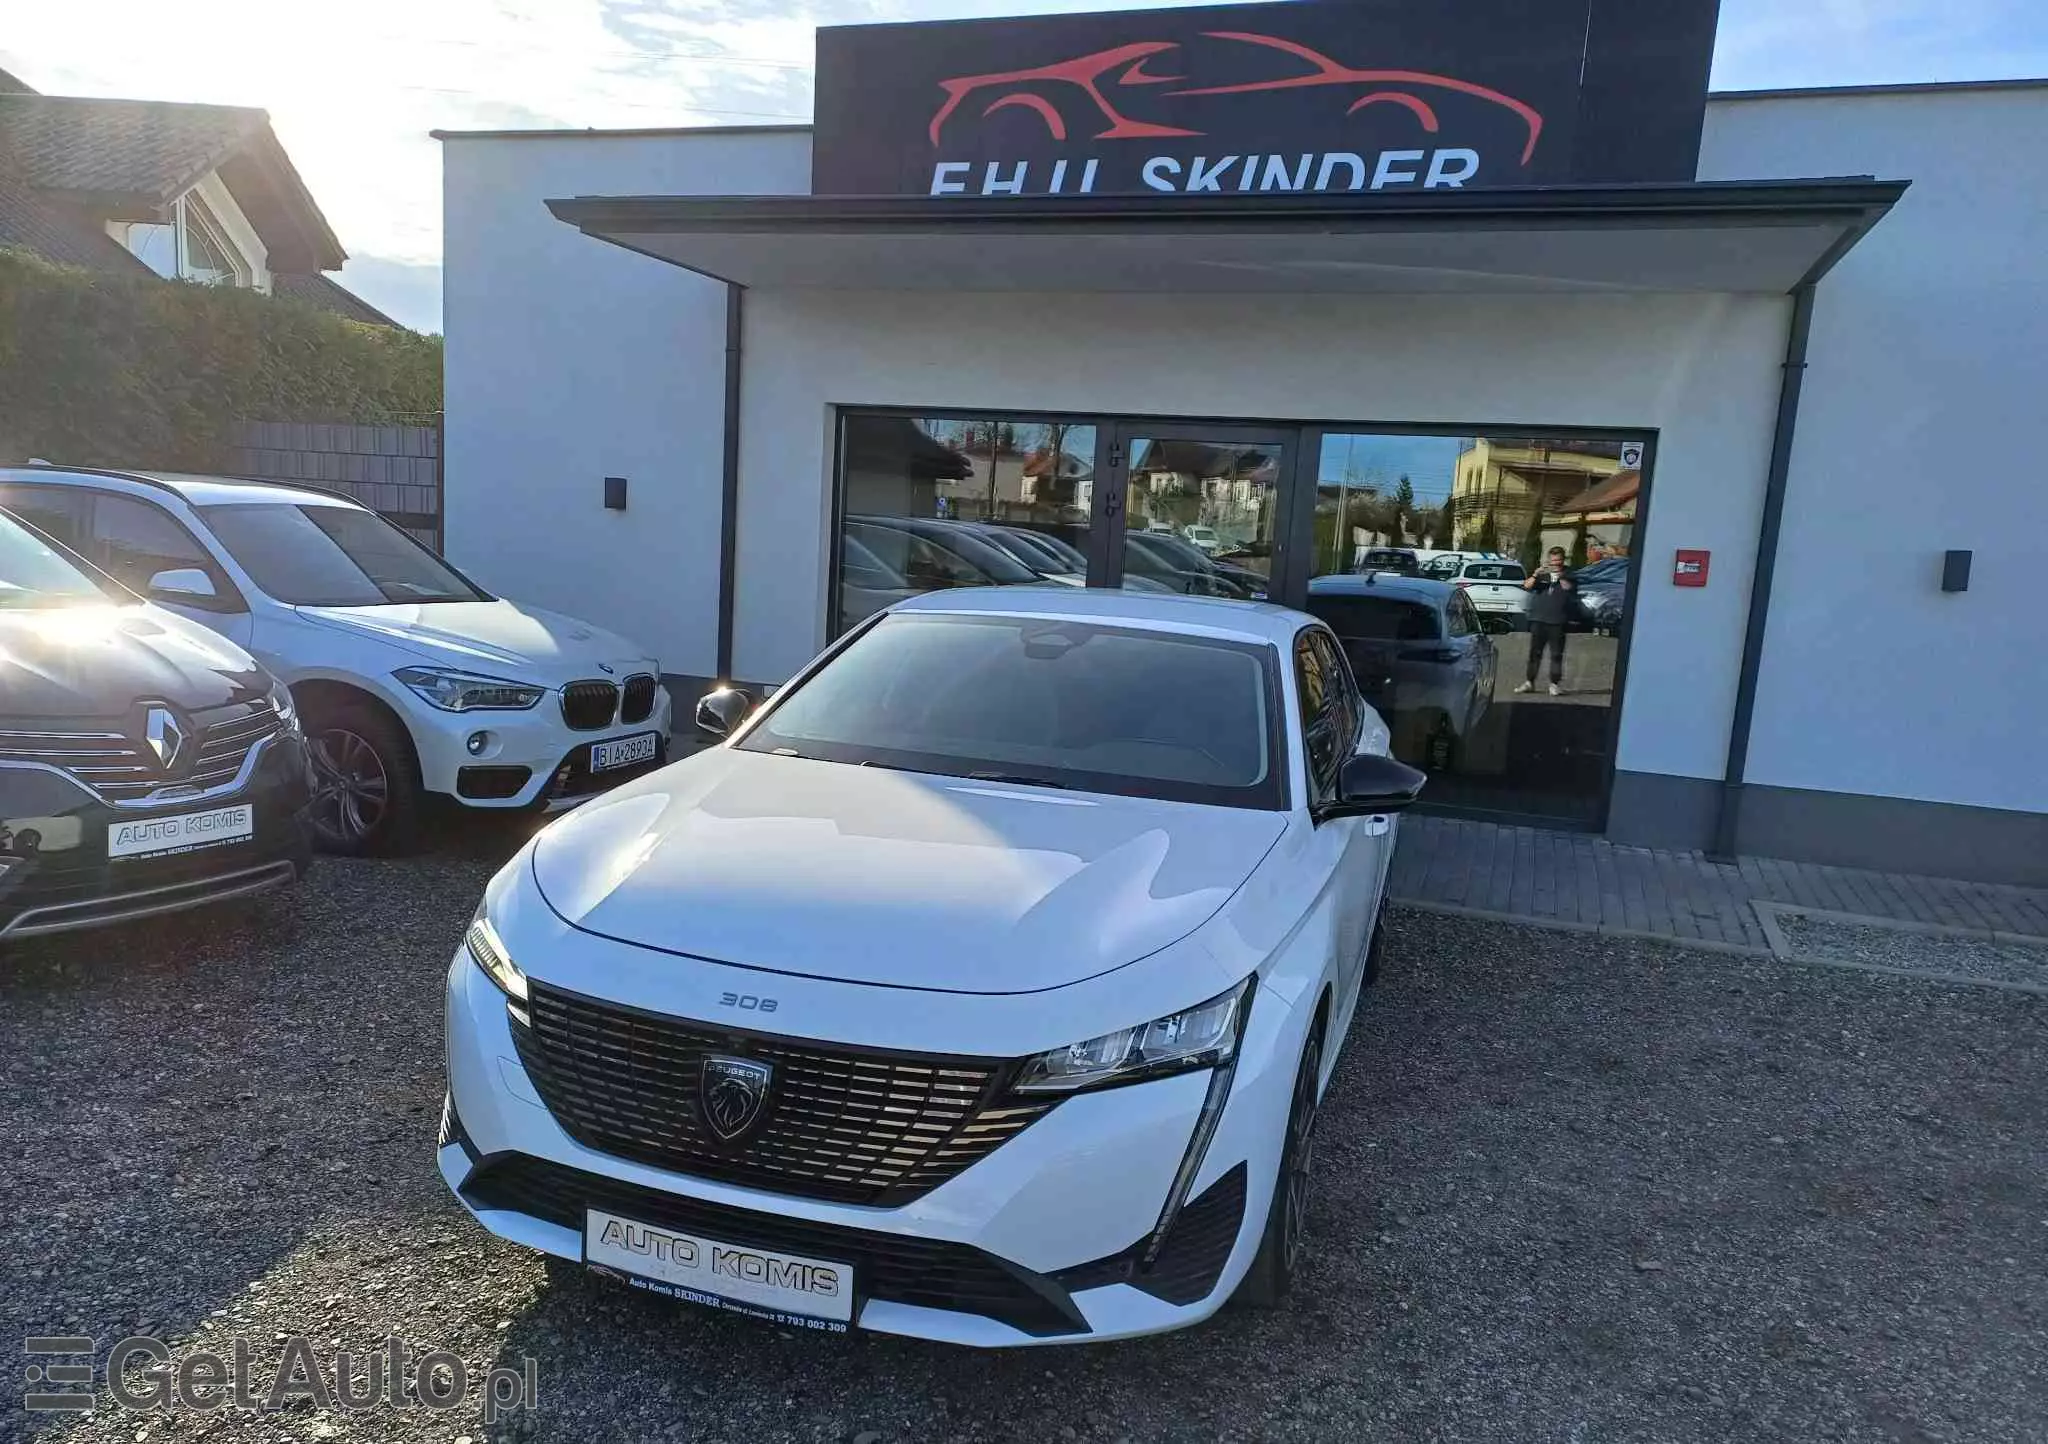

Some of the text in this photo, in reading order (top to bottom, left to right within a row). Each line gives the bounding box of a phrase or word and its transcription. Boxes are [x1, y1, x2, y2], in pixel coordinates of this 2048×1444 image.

[1142, 148, 1480, 192] SKINDER
[116, 809, 247, 845] AUTO KOMIS
[719, 992, 778, 1013] 308
[707, 1064, 761, 1080] PEUGEOT
[600, 1220, 839, 1297] AUTO KOMIS
